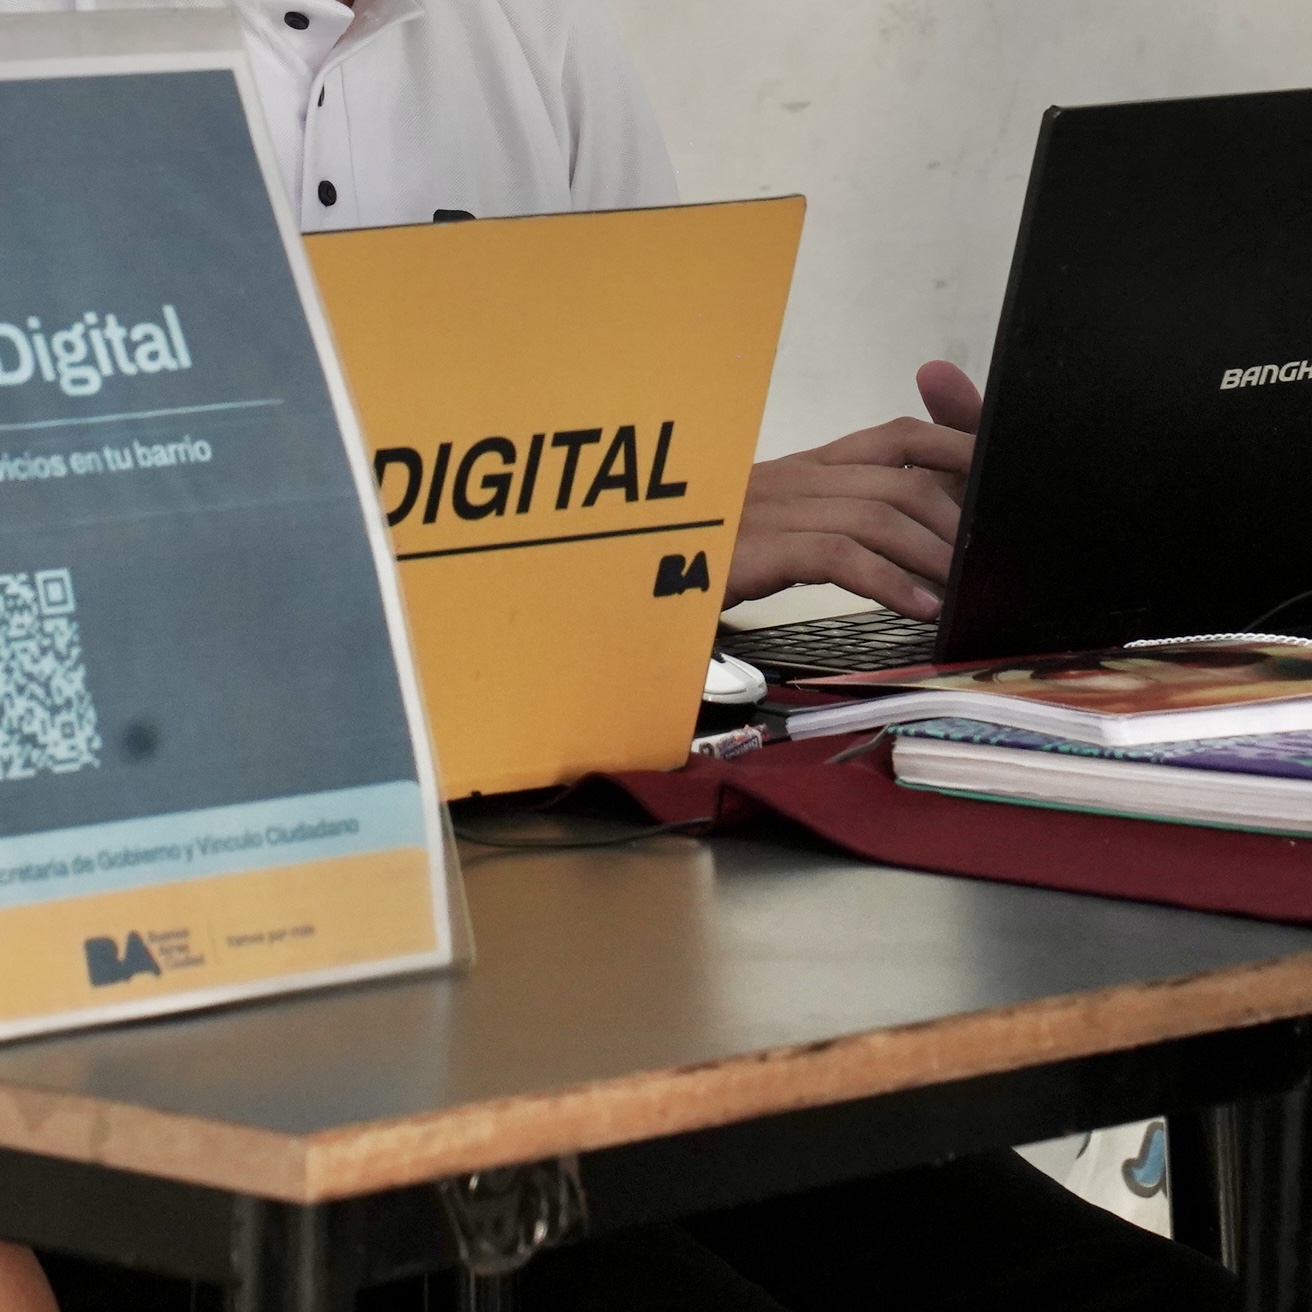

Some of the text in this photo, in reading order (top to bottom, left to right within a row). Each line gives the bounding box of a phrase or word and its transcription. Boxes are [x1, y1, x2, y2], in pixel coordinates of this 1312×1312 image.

[70, 451, 103, 474] en
[102, 445, 134, 471] tu
[133, 435, 213, 469] barrio
[373, 420, 689, 528] DIGITAL
[652, 550, 711, 598] BA
[71, 854, 95, 875] de
[96, 842, 182, 872] Gobierno
[182, 844, 195, 863] y
[264, 816, 360, 846] Ciudadano
[84, 930, 162, 988] BA
